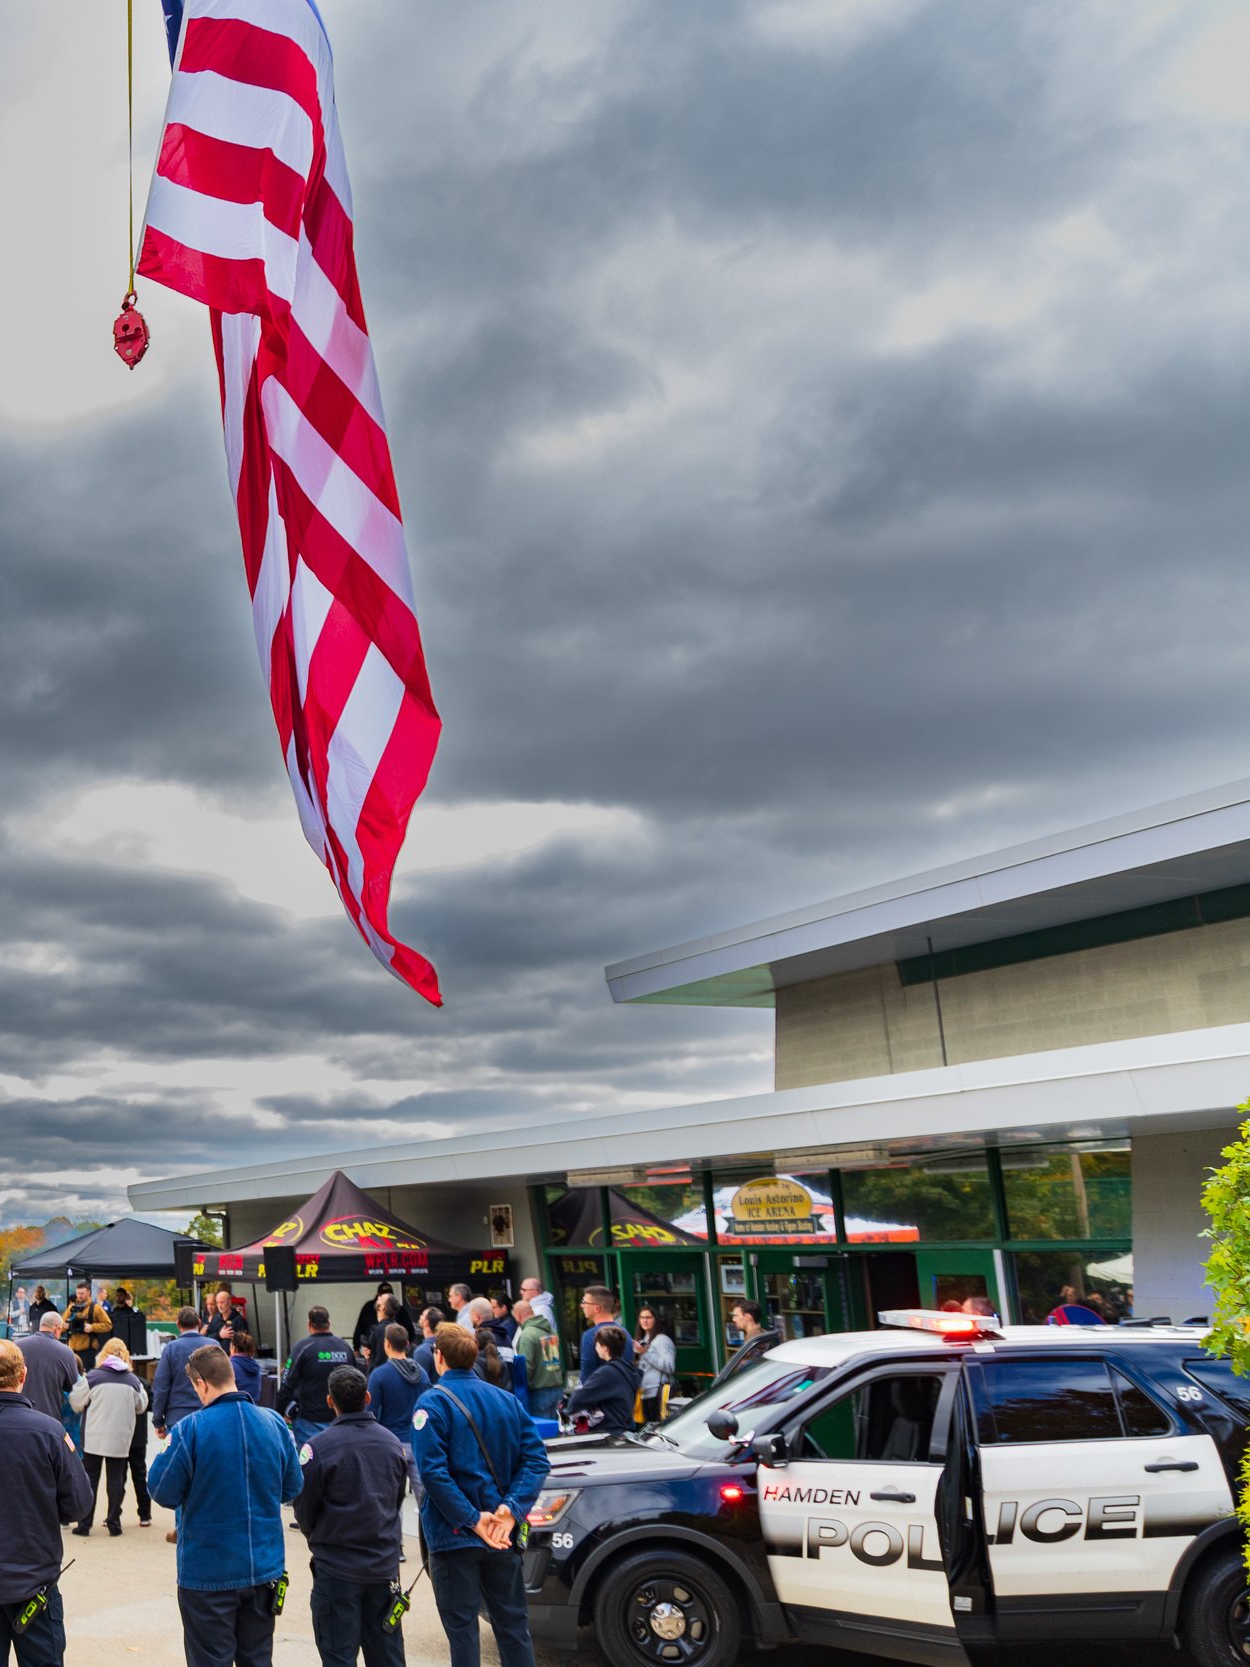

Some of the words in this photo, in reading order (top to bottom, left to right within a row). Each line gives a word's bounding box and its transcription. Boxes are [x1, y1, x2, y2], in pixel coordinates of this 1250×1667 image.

[738, 1194, 762, 1206] Louis
[766, 1192, 805, 1205] Astorino
[748, 1207, 762, 1217] ICE
[766, 1206, 796, 1217] ARENA
[325, 1221, 397, 1241] CHAZ
[364, 1251, 429, 1269] WPLR.COM
[470, 1260, 505, 1274] PLR
[1176, 1386, 1203, 1402] 56
[763, 1486, 861, 1506] HAMDEN
[551, 1532, 574, 1549] 56
